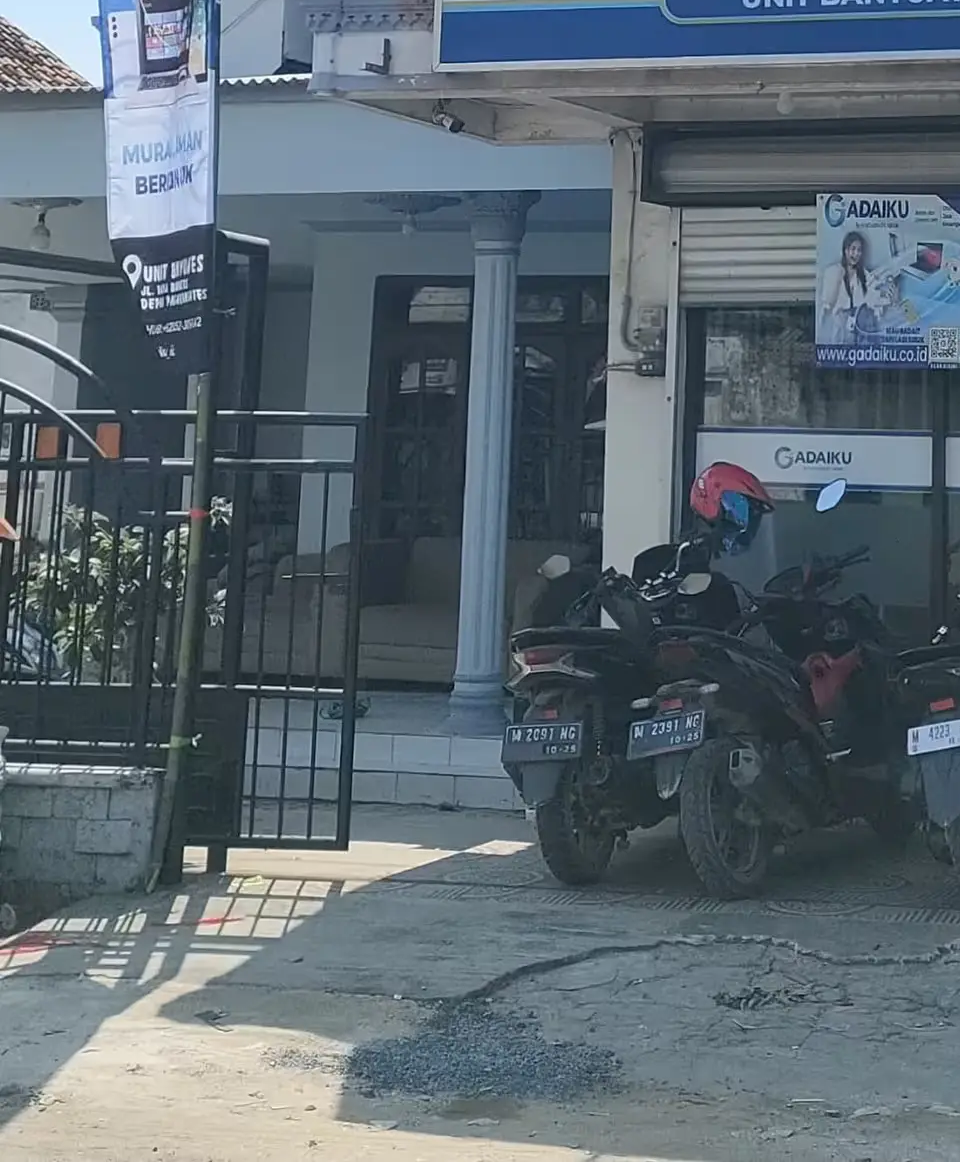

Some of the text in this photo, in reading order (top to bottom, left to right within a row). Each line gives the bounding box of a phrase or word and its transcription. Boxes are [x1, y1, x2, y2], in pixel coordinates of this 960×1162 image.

[825, 193, 909, 228] GADAIKU
[816, 345, 928, 365] www.gadaiku.co.id
[774, 446, 852, 470] GADAIKU
[525, 727, 554, 742] 2091
[560, 726, 577, 739] NG
[651, 720, 679, 737] 2391
[686, 714, 700, 730] NG
[928, 724, 951, 741] 4223
